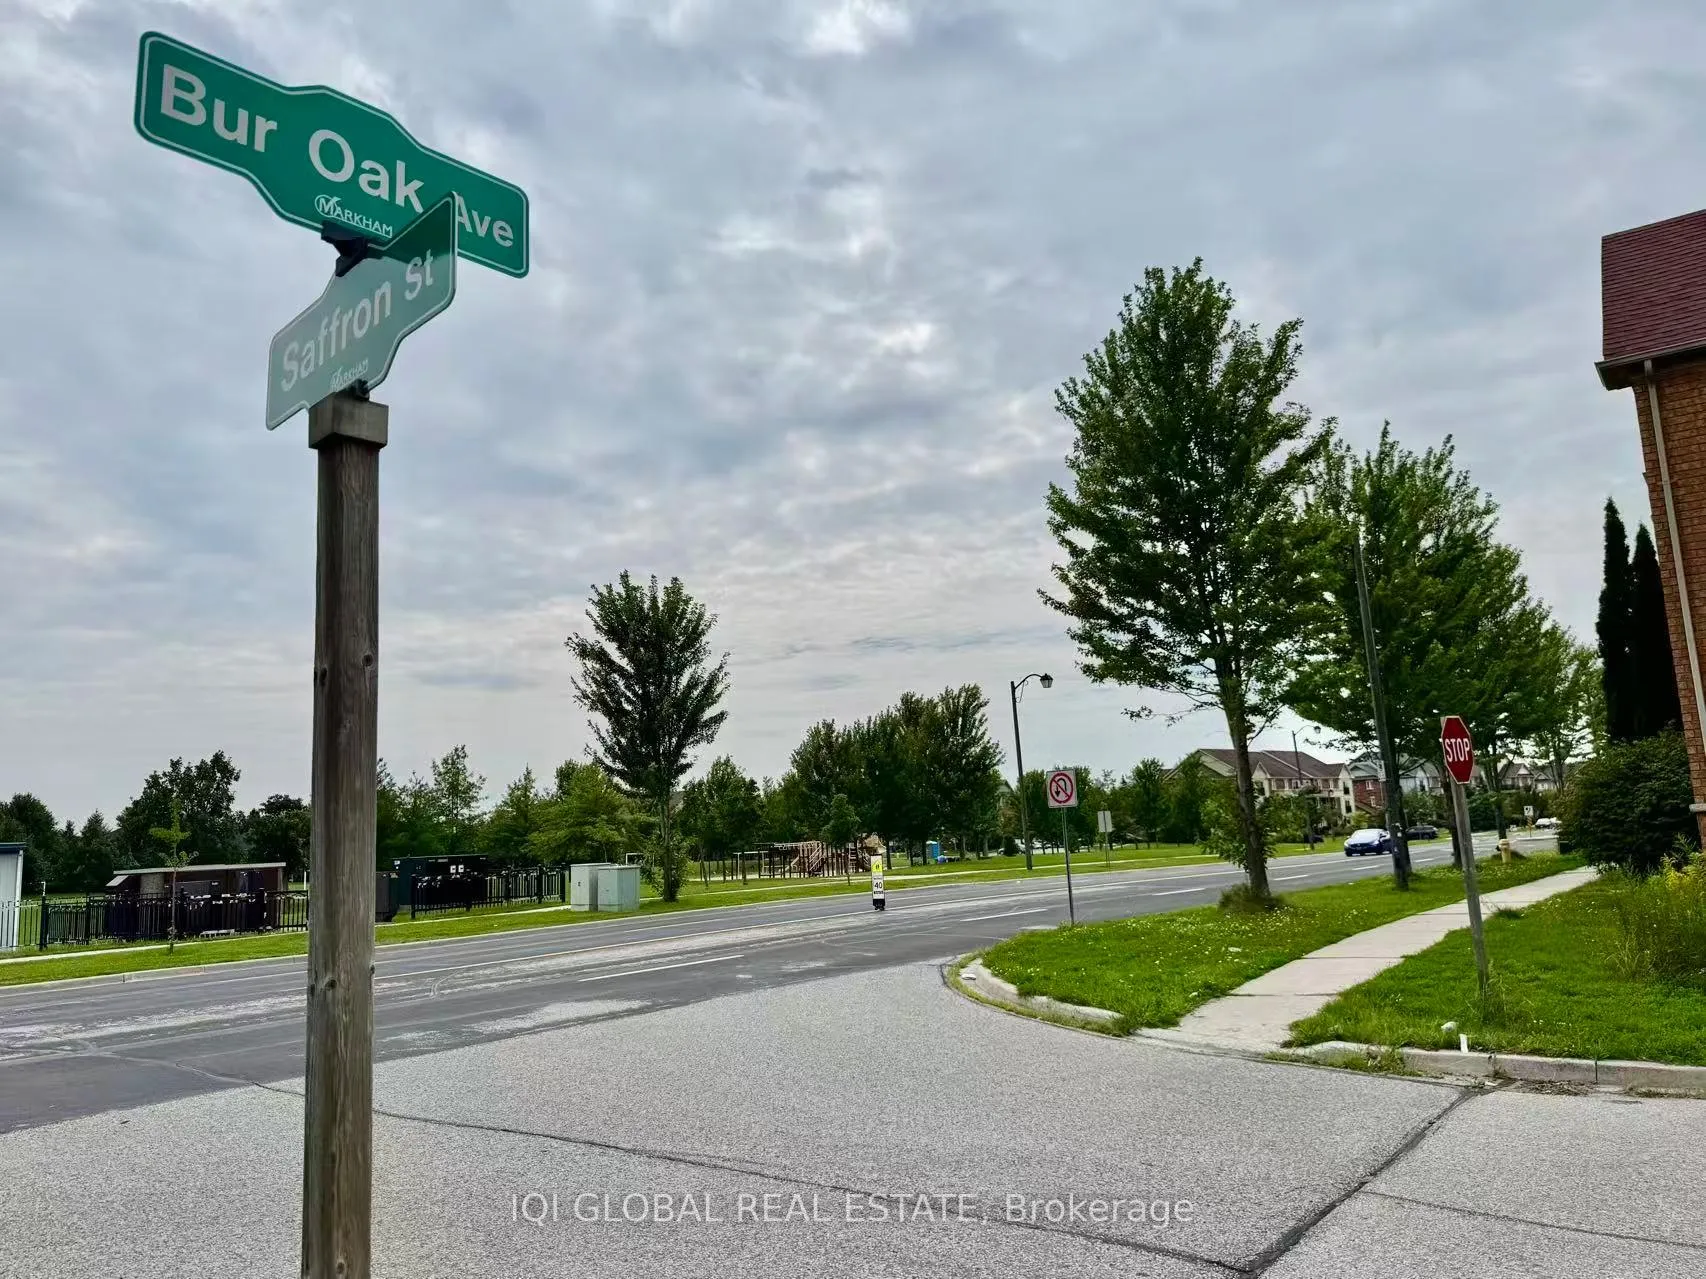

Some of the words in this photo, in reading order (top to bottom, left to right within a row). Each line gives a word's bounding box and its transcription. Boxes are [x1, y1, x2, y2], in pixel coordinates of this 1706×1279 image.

[160, 63, 278, 153] Bur
[308, 129, 425, 214] Oak
[456, 195, 514, 247] Ave
[315, 194, 394, 238] MARKHAM
[280, 280, 392, 393] Saffron
[404, 248, 434, 301] St
[1444, 738, 1470, 762] STOP
[874, 881, 883, 889] 40
